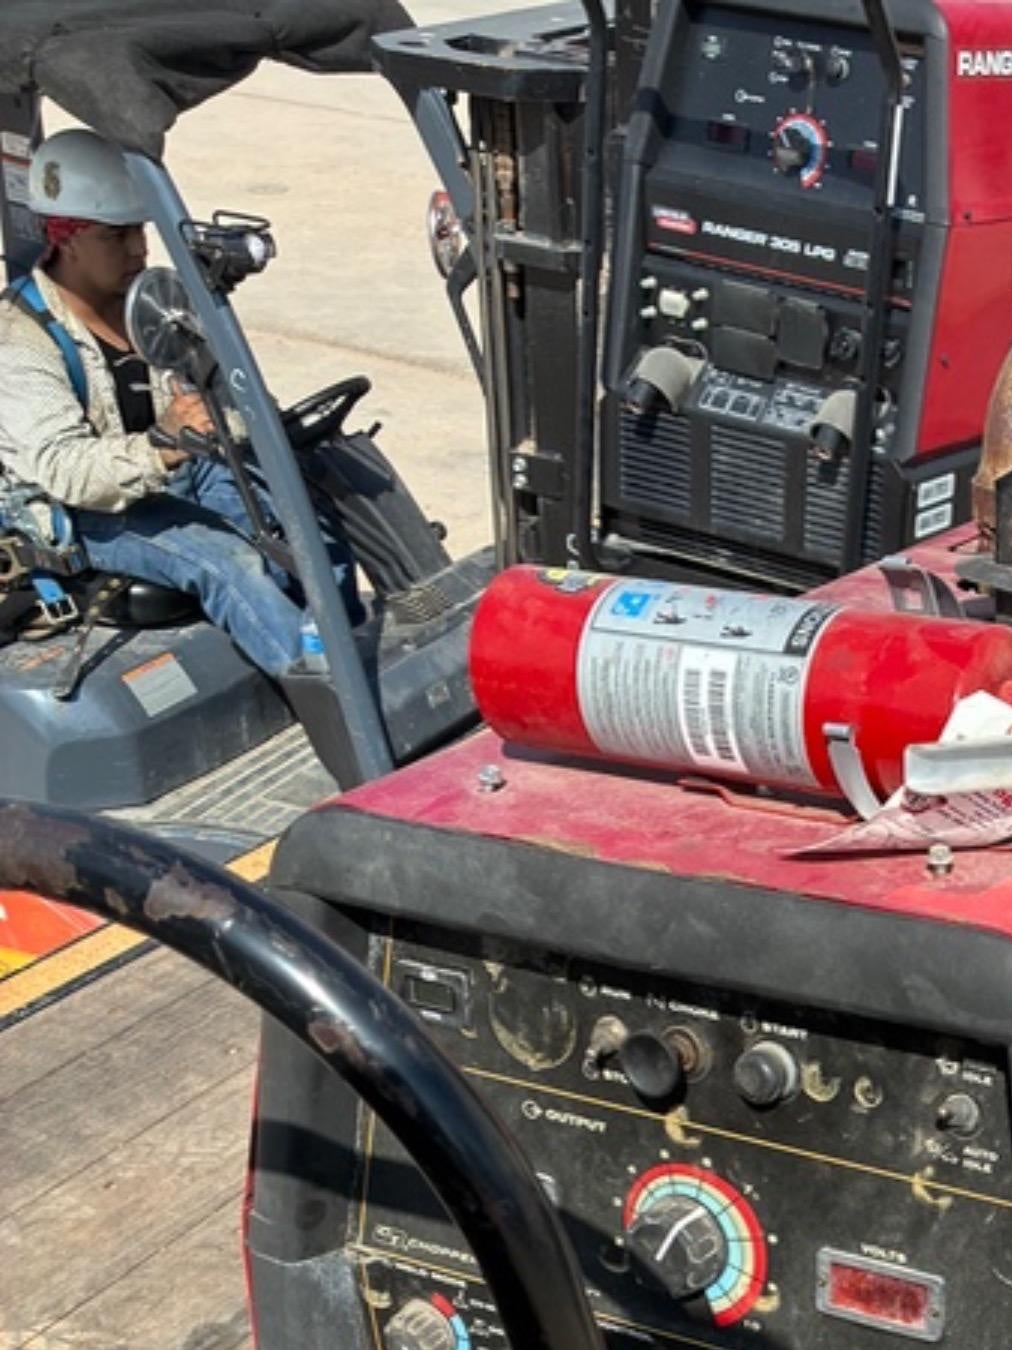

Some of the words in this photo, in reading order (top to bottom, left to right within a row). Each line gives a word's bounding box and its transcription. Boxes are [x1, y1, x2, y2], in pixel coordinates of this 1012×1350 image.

[701, 220, 767, 247] RANGER
[761, 1021, 808, 1040] START
[545, 1108, 607, 1133] OUTPUT
[861, 1243, 907, 1264] VOLTS
